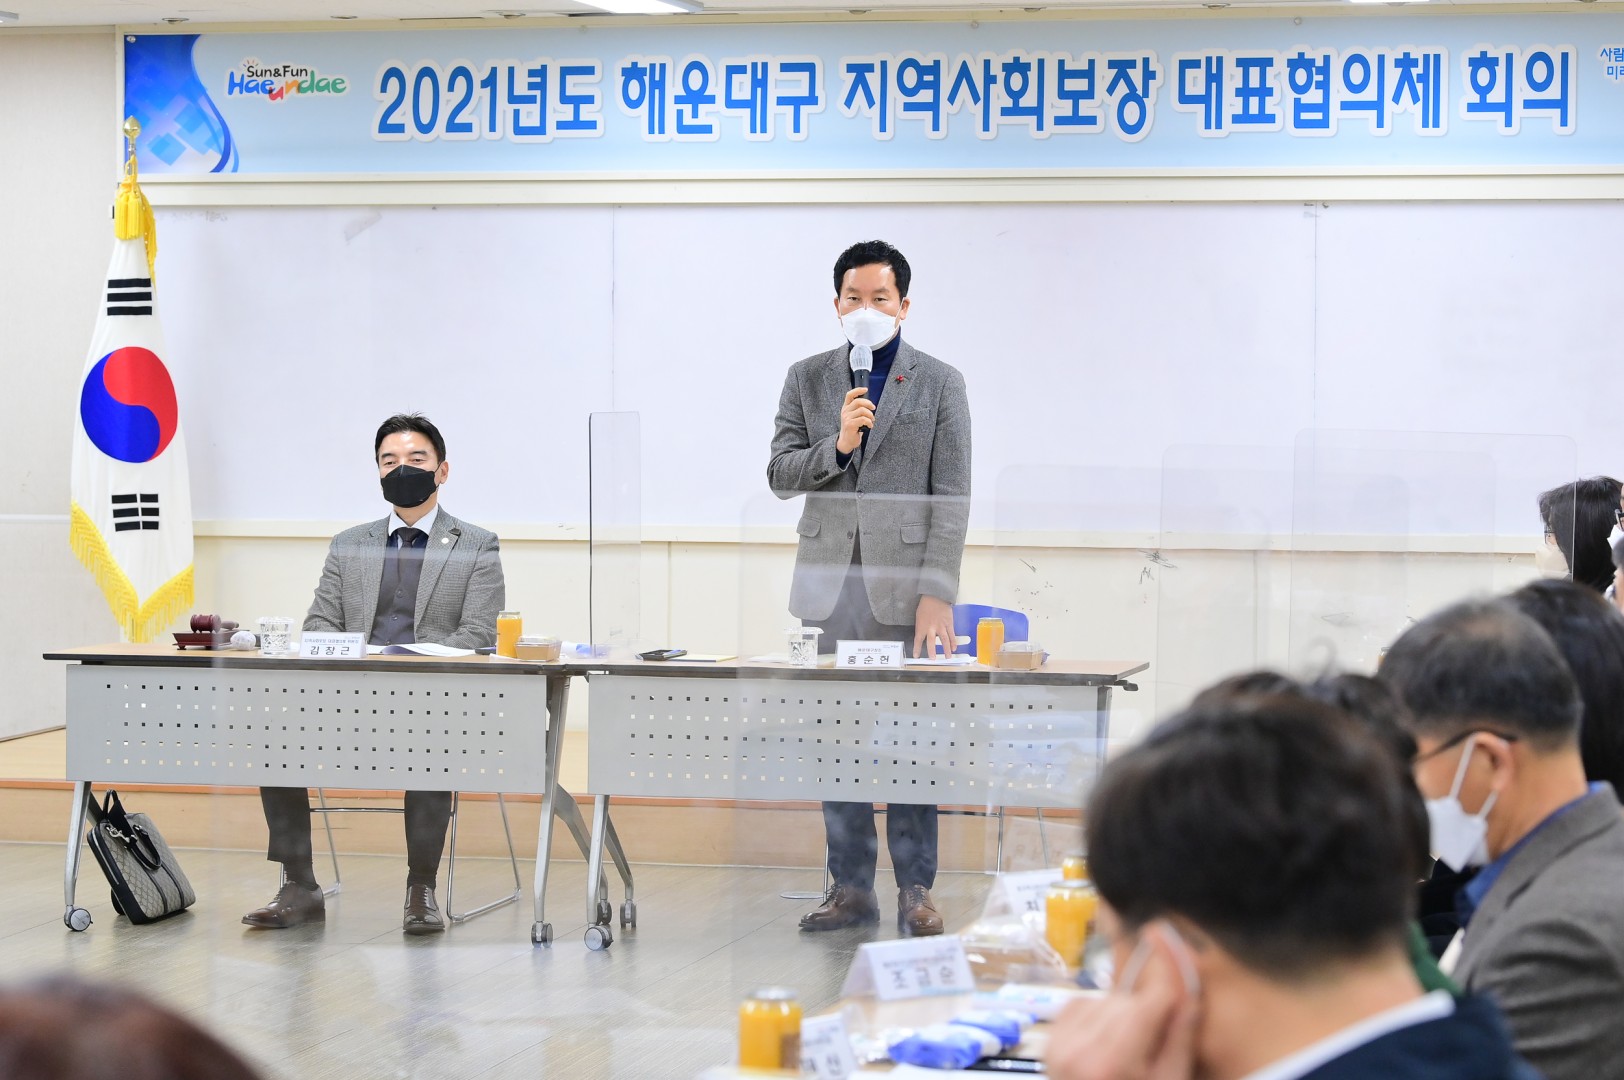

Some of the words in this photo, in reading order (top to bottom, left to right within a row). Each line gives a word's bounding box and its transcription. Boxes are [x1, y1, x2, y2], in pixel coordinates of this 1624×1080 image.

[227, 69, 347, 101] Haeundae
[246, 64, 308, 78] Sun&Fun
[378, 62, 598, 137] 2021년도
[621, 61, 819, 135] 해운대구
[843, 57, 1156, 135] 지역사회보장
[1178, 51, 1441, 130] 대표협의체
[1466, 50, 1569, 128] 회의
